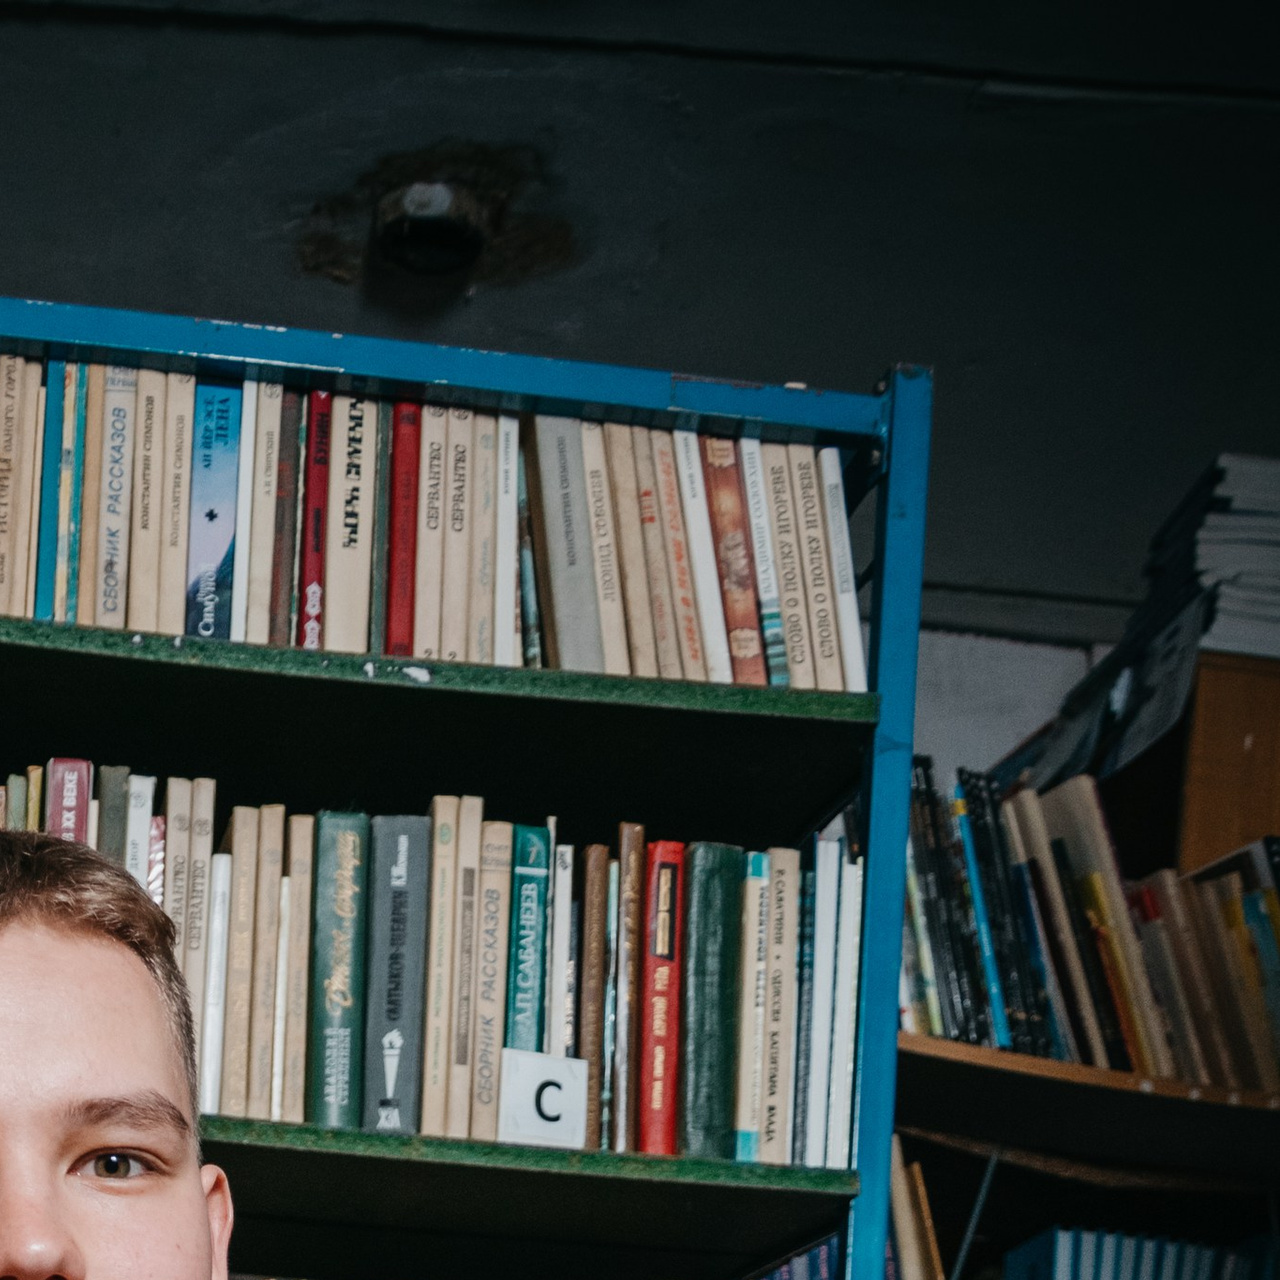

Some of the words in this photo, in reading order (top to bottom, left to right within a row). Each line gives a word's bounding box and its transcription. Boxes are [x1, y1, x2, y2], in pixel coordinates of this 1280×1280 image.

[141, 396, 155, 451] СИМОНОВ
[172, 415, 186, 469] СИМОНОВ
[106, 406, 127, 515] РАССКАЗОВ
[140, 455, 153, 531] КОНСТАНТИН
[426, 441, 444, 530] СЕРВАНТЕС
[450, 444, 467, 532] СЕРВАНТЕС
[556, 435, 569, 490] СИМОНОВ
[797, 460, 820, 530] ИГОРЕВЕ
[169, 473, 183, 548] КОНСТАНТИН
[561, 491, 577, 566] КОНСТАНТИН
[589, 469, 608, 538] СОБОЛЕВ
[770, 465, 791, 534] ИГОРЕВЕ
[101, 527, 121, 613] СБОРНИК
[598, 542, 616, 602] ЛЕОНИД
[755, 522, 775, 594] ВЛАДИМИР
[778, 539, 798, 592] ПОЛКУ
[807, 535, 827, 587] ПОЛКУ
[786, 596, 798, 606] О
[816, 592, 827, 601] О
[787, 613, 805, 664] СЛОВО
[819, 607, 836, 659] СЛОВО
[63, 771, 79, 807] ВЕКЕ
[171, 854, 186, 946] СЕРВАНТЕС
[188, 859, 206, 951] СЕРВАНТЕС
[481, 889, 501, 1000] РАССКАЗОВ
[475, 1015, 495, 1106] СБОРНИК
[534, 1080, 563, 1122] С
